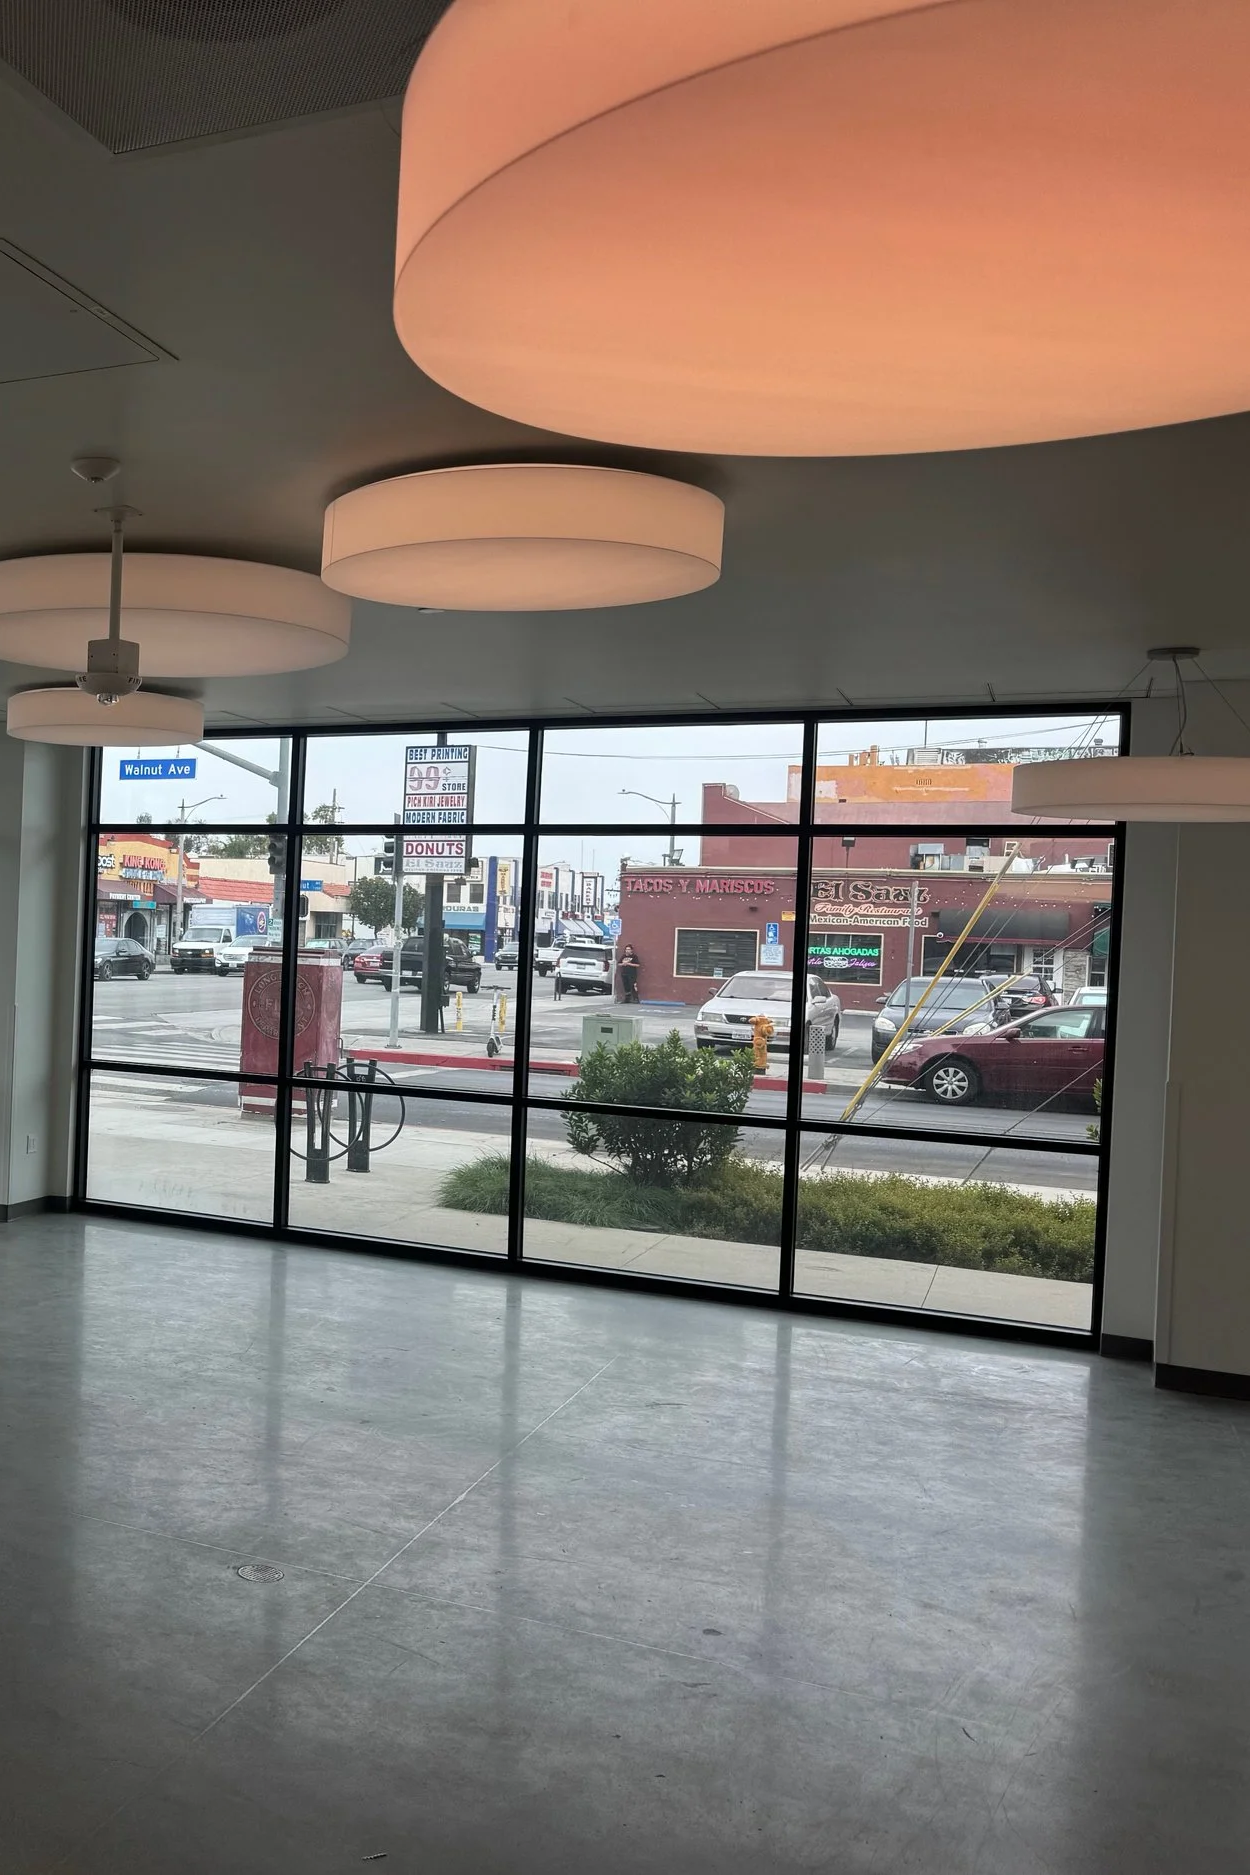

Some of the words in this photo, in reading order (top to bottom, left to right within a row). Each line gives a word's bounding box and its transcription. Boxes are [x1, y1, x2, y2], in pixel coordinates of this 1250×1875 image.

[409, 749, 427, 760] BEST
[431, 747, 468, 760] PRINTING
[124, 764, 162, 775] Walnut
[168, 763, 190, 775] Ave
[442, 783, 466, 791] STORE
[407, 796, 422, 807] PICH
[422, 796, 436, 807] KIRI
[437, 796, 465, 807] JEWELRY
[406, 812, 436, 824] MODERN
[438, 811, 465, 823] FABRIC
[405, 843, 464, 855] DONUTS
[124, 855, 144, 867] KING
[145, 857, 166, 870] KONG
[624, 878, 673, 892] TACOS
[679, 879, 690, 893] Y
[695, 879, 775, 894] MARISCOS
[811, 880, 844, 901] El
[814, 903, 856, 917] Family
[857, 904, 923, 915] Restaurat
[809, 914, 899, 926] Mexican-American
[832, 947, 879, 956] AHOGADAS
[254, 974, 277, 994] LONG
